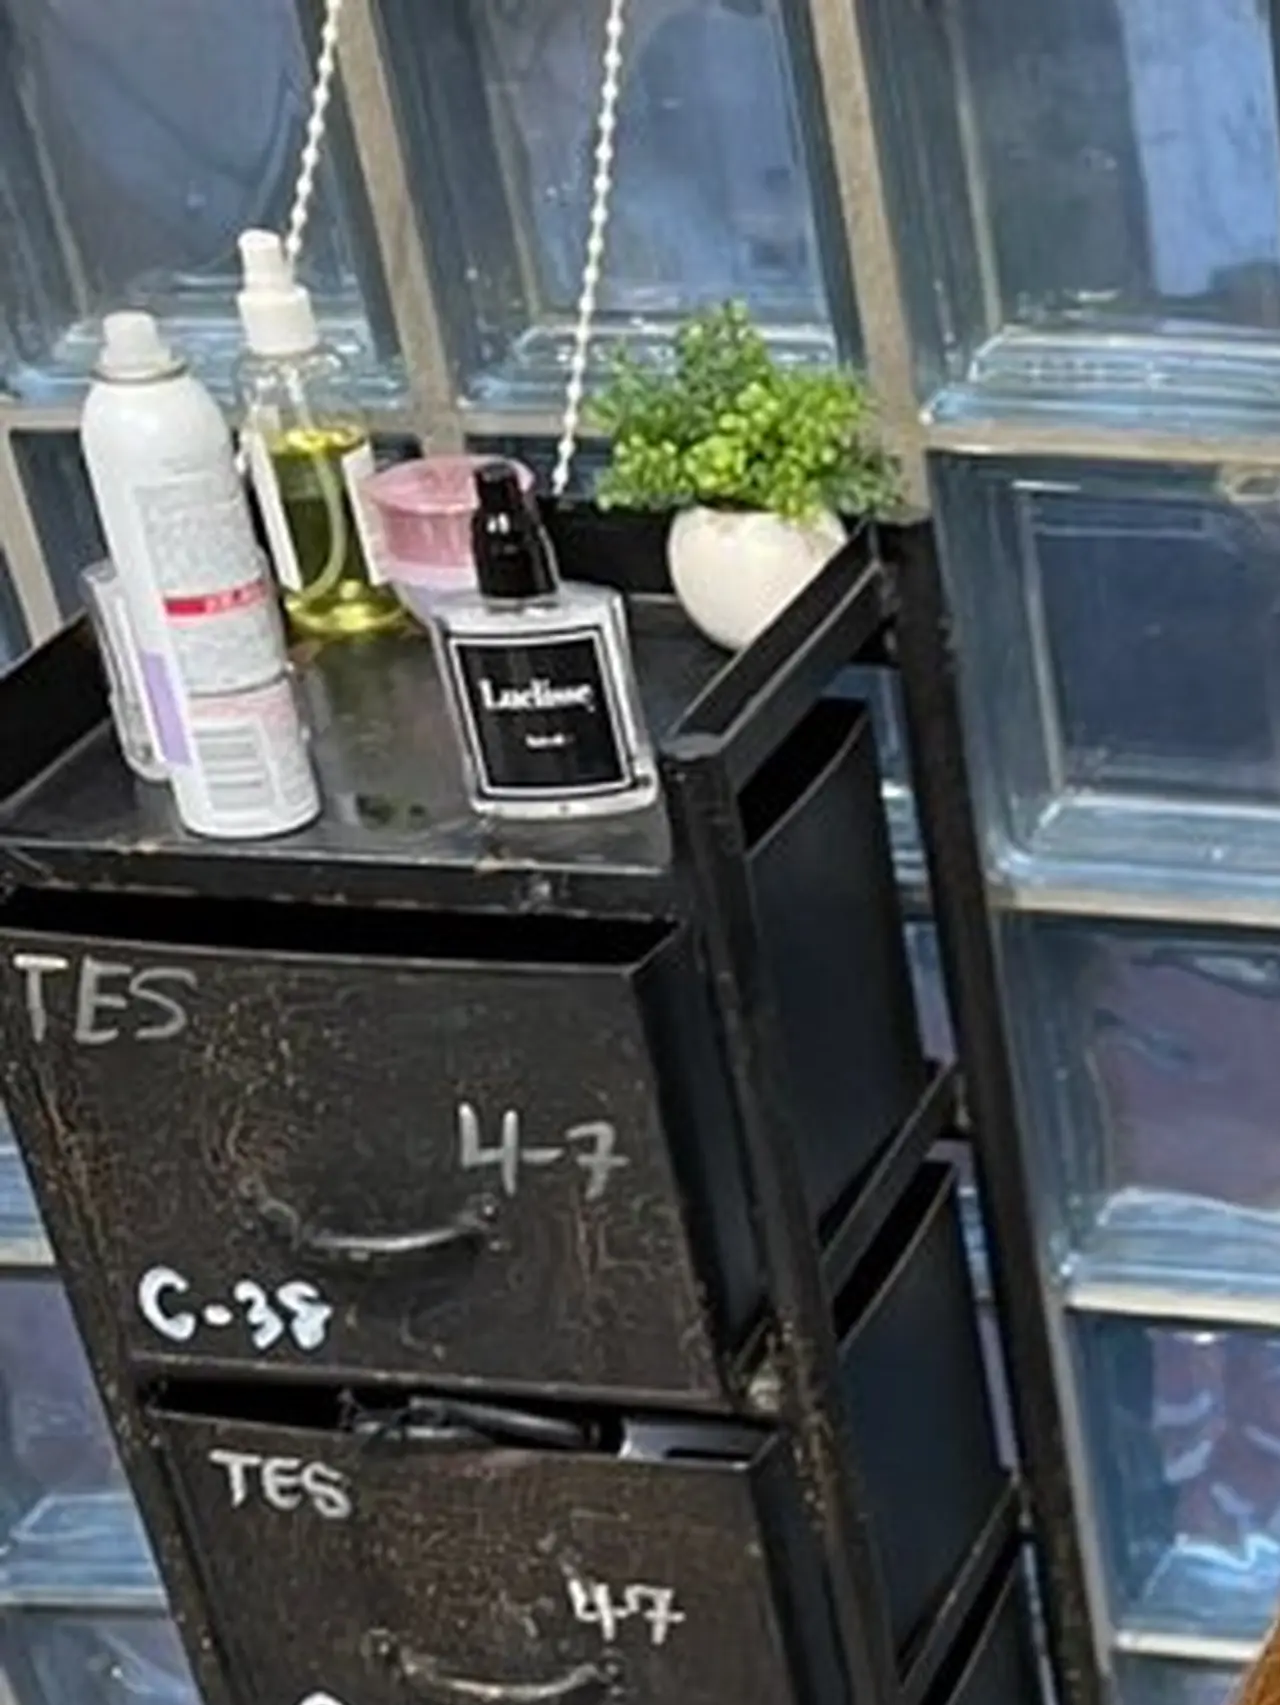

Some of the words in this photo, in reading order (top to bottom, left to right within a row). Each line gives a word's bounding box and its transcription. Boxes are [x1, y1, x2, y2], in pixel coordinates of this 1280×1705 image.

[13, 954, 196, 1045] TES
[458, 1102, 629, 1200] 4-7
[209, 1450, 353, 1519] TES
